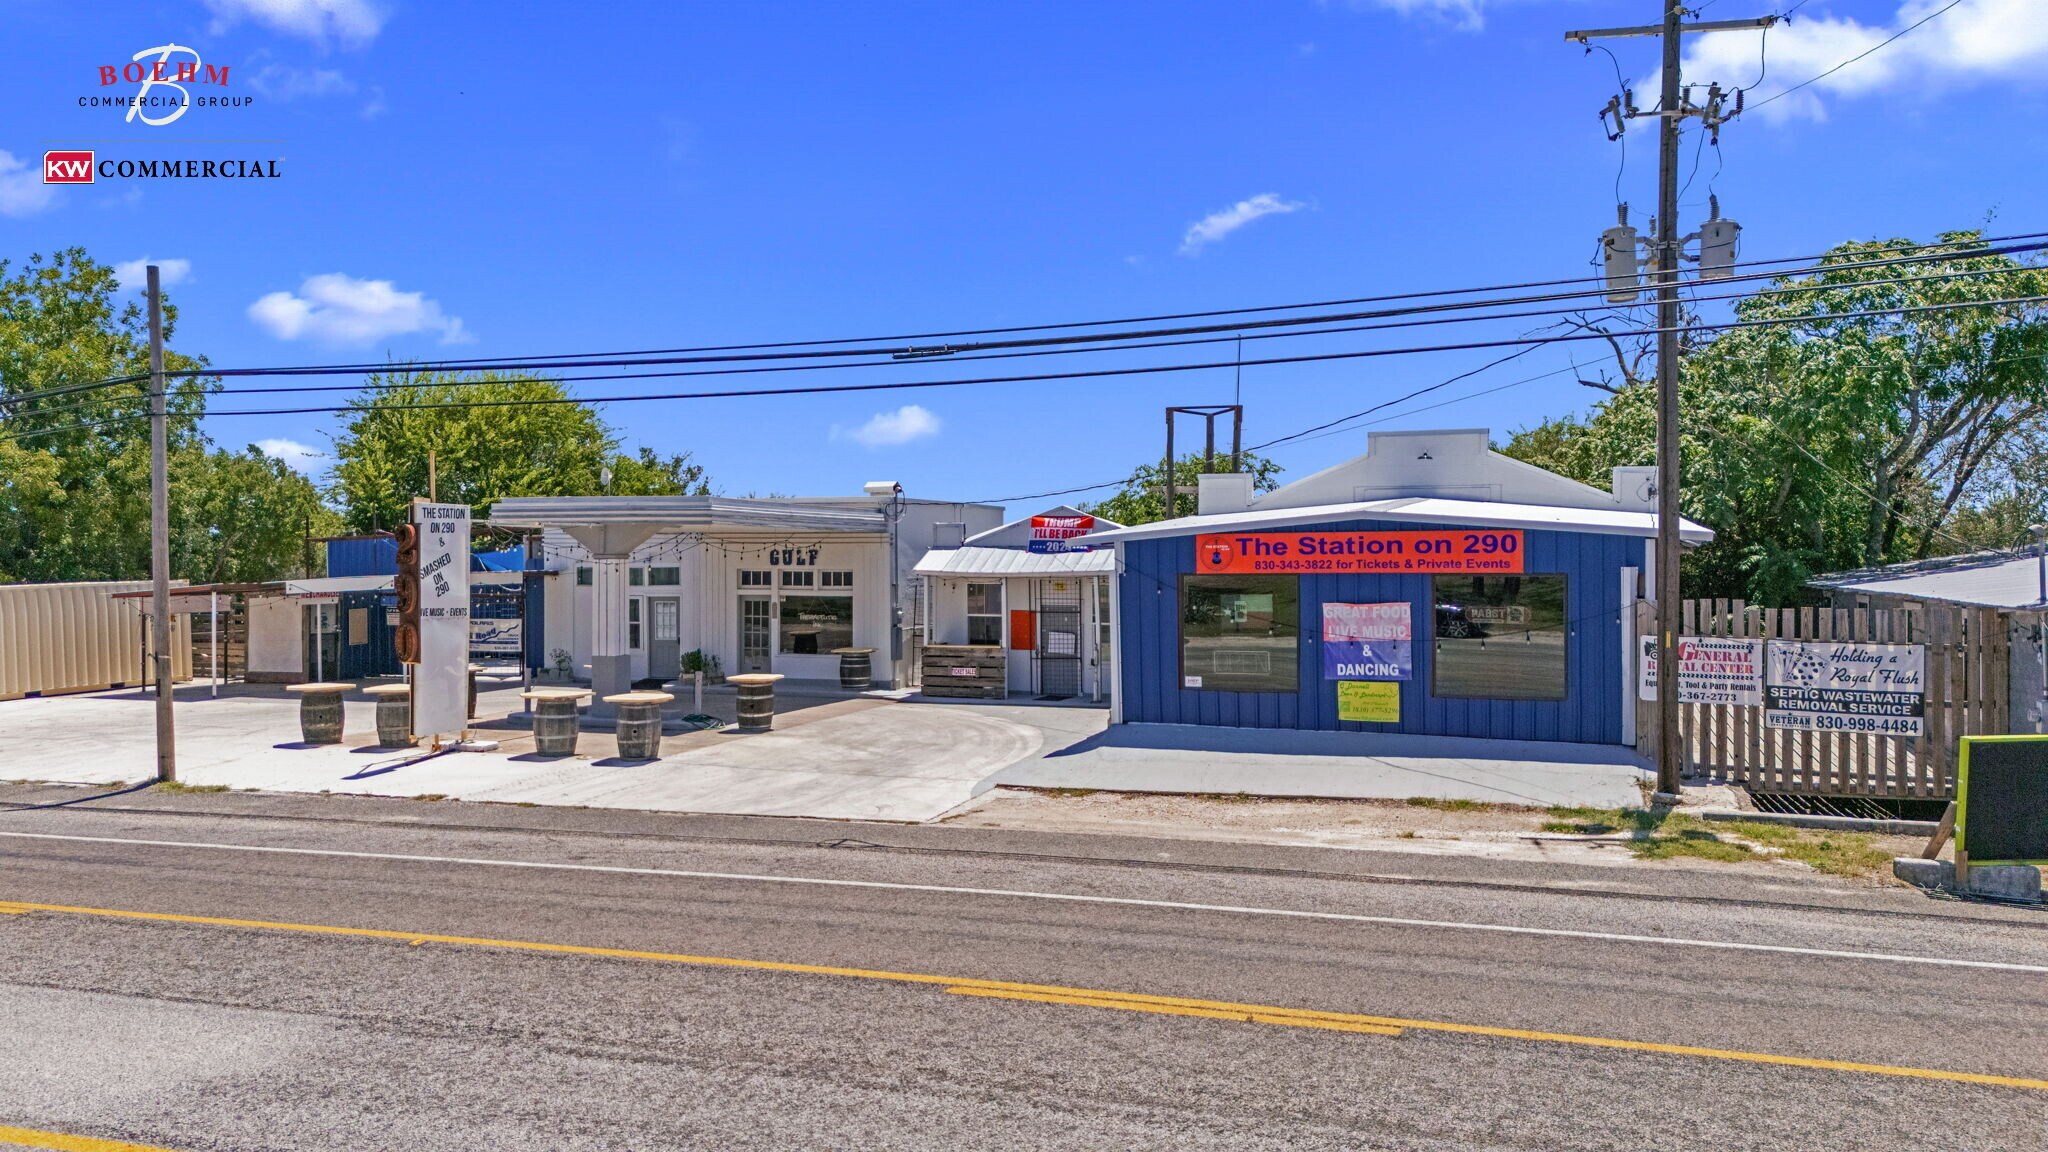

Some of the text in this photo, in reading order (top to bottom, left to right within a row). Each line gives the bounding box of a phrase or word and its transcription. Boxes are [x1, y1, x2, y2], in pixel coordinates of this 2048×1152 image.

[422, 508, 466, 519] THE STATION
[430, 522, 455, 534] ON 290
[1043, 517, 1082, 528] TRUMP
[1034, 528, 1088, 540] I'LL BE BACK
[439, 537, 446, 547] &
[1235, 534, 1518, 556] The Station on 290
[769, 549, 818, 566] GULF
[1254, 558, 1511, 570] 830-343-3822 for Tickets & Private Events
[420, 552, 452, 580] SMASHED
[433, 572, 444, 586] ON
[435, 581, 450, 598] 290
[429, 608, 444, 617] MUSIC
[450, 607, 468, 617] EVENTS
[1325, 606, 1410, 619] GREAT FOOD
[1471, 608, 1506, 619] PABST
[1328, 625, 1406, 638] LIVE MUSIC
[1362, 644, 1373, 657] &
[1678, 641, 1752, 663] GENERAL
[1830, 646, 1898, 669] Holding a
[1337, 663, 1399, 676] DANCING
[1701, 663, 1754, 674] CENTER
[1829, 667, 1919, 688] Royal Flush
[1685, 682, 1700, 690] Tool
[1701, 682, 1707, 690] &
[1709, 682, 1728, 692] Party
[1730, 683, 1757, 692] Rentals
[1770, 687, 1920, 704] SEPTIC WASTEWATER
[1778, 699, 1912, 716] REMOVAL SERVICE
[1769, 715, 1811, 726] VETERAN
[1816, 715, 1919, 733] 830-998-4484
